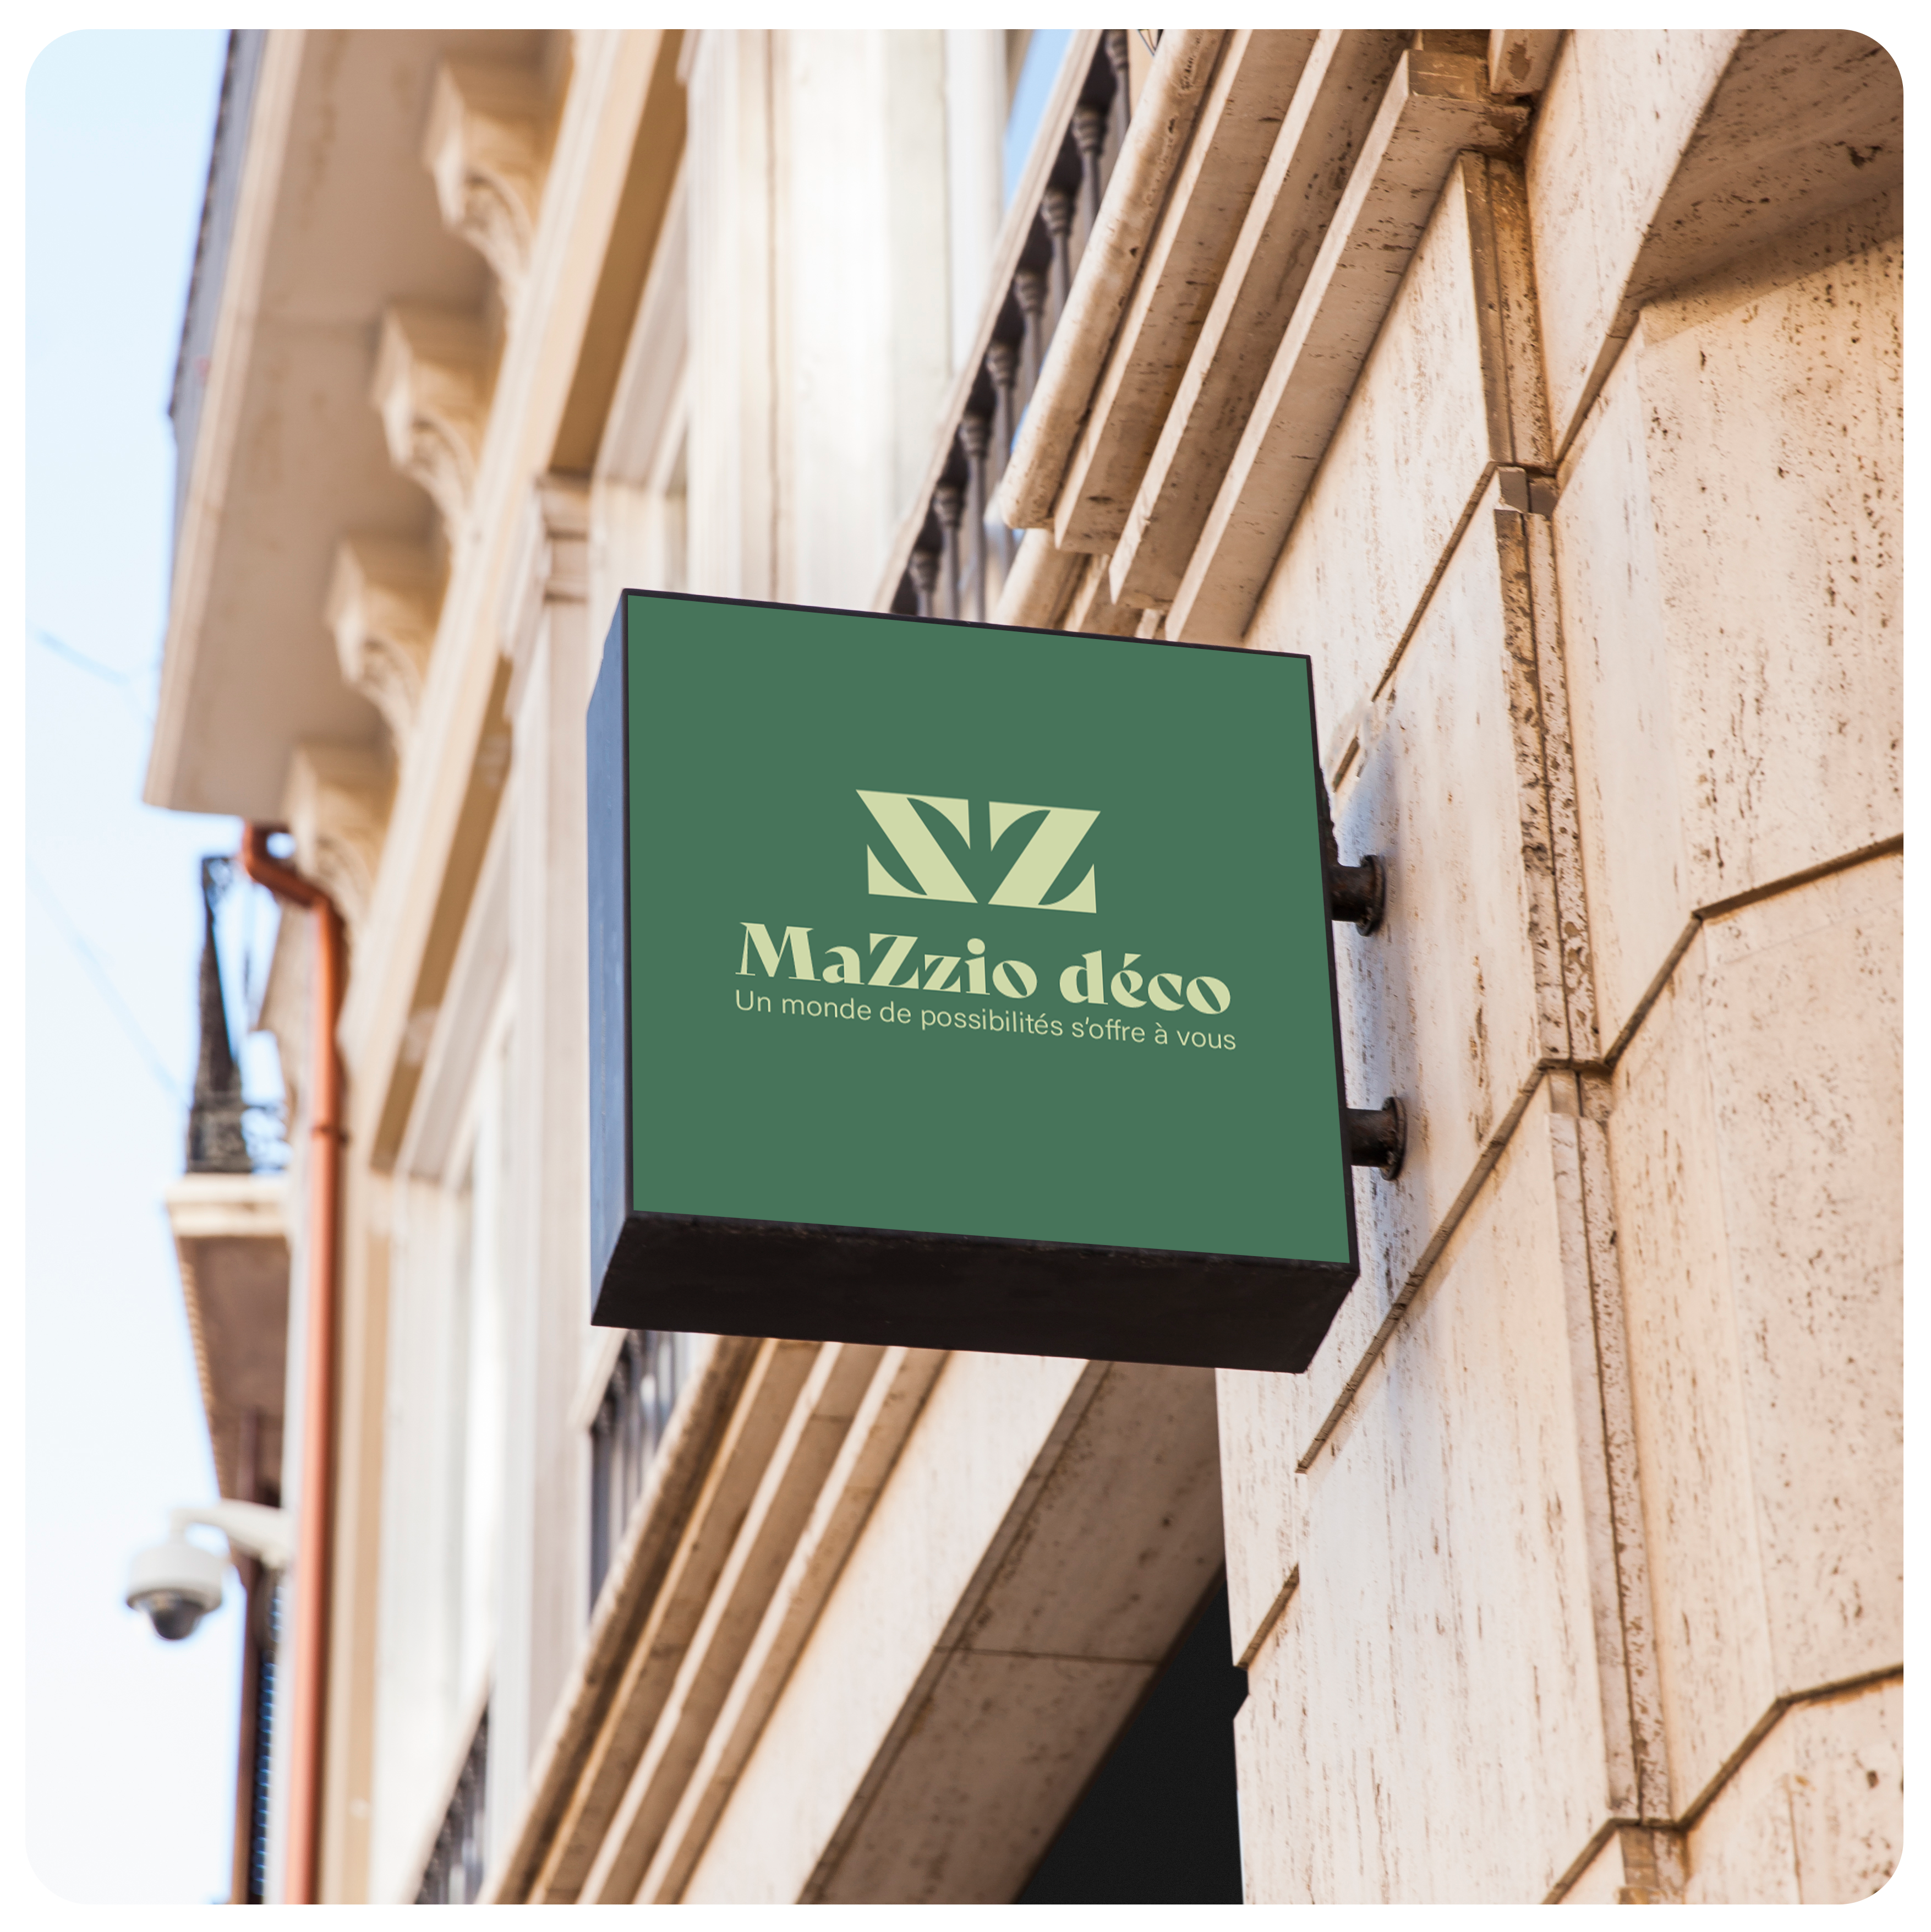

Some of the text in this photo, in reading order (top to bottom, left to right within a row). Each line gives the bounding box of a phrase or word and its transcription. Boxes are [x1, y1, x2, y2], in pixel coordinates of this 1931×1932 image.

[735, 922, 1231, 1014] MaZzio déco
[736, 989, 771, 1013] Un
[782, 995, 872, 1020] monde
[879, 1001, 911, 1024] de
[921, 1008, 1063, 1036] possibilités
[1155, 1022, 1168, 1045] à
[1177, 1030, 1236, 1050] vous
